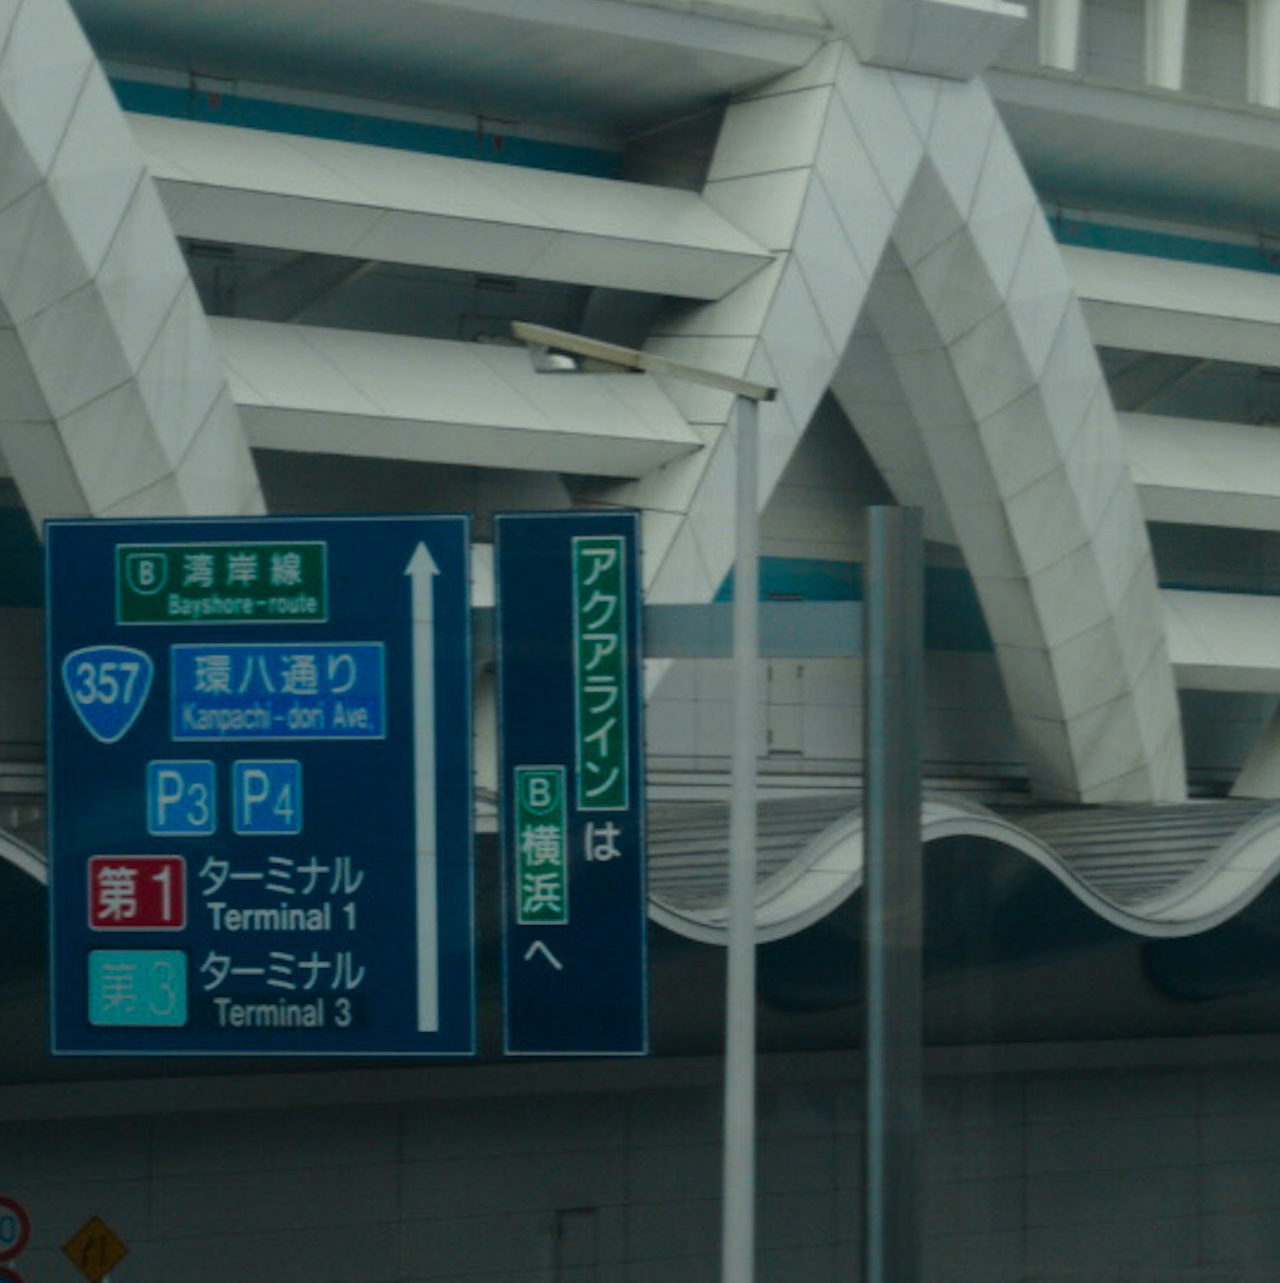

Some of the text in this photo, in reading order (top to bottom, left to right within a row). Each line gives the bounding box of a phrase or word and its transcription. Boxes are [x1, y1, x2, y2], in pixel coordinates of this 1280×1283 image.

[139, 559, 155, 586] B
[181, 552, 302, 589] 湾岸線
[75, 662, 140, 705] 357
[194, 653, 357, 695] 環八通り
[581, 547, 620, 798] アクアライン
[333, 701, 375, 730] Ave.
[157, 769, 210, 826] P3
[242, 768, 295, 826] P4
[529, 778, 551, 807] B
[583, 820, 622, 862] は
[198, 855, 365, 897] ターミナル
[521, 823, 562, 914] 横浜
[97, 865, 173, 922] 第1
[206, 901, 357, 931] Terminal 1
[199, 950, 367, 992] ターミナル
[523, 939, 564, 971] へ
[212, 996, 353, 1027] Terminal 3
